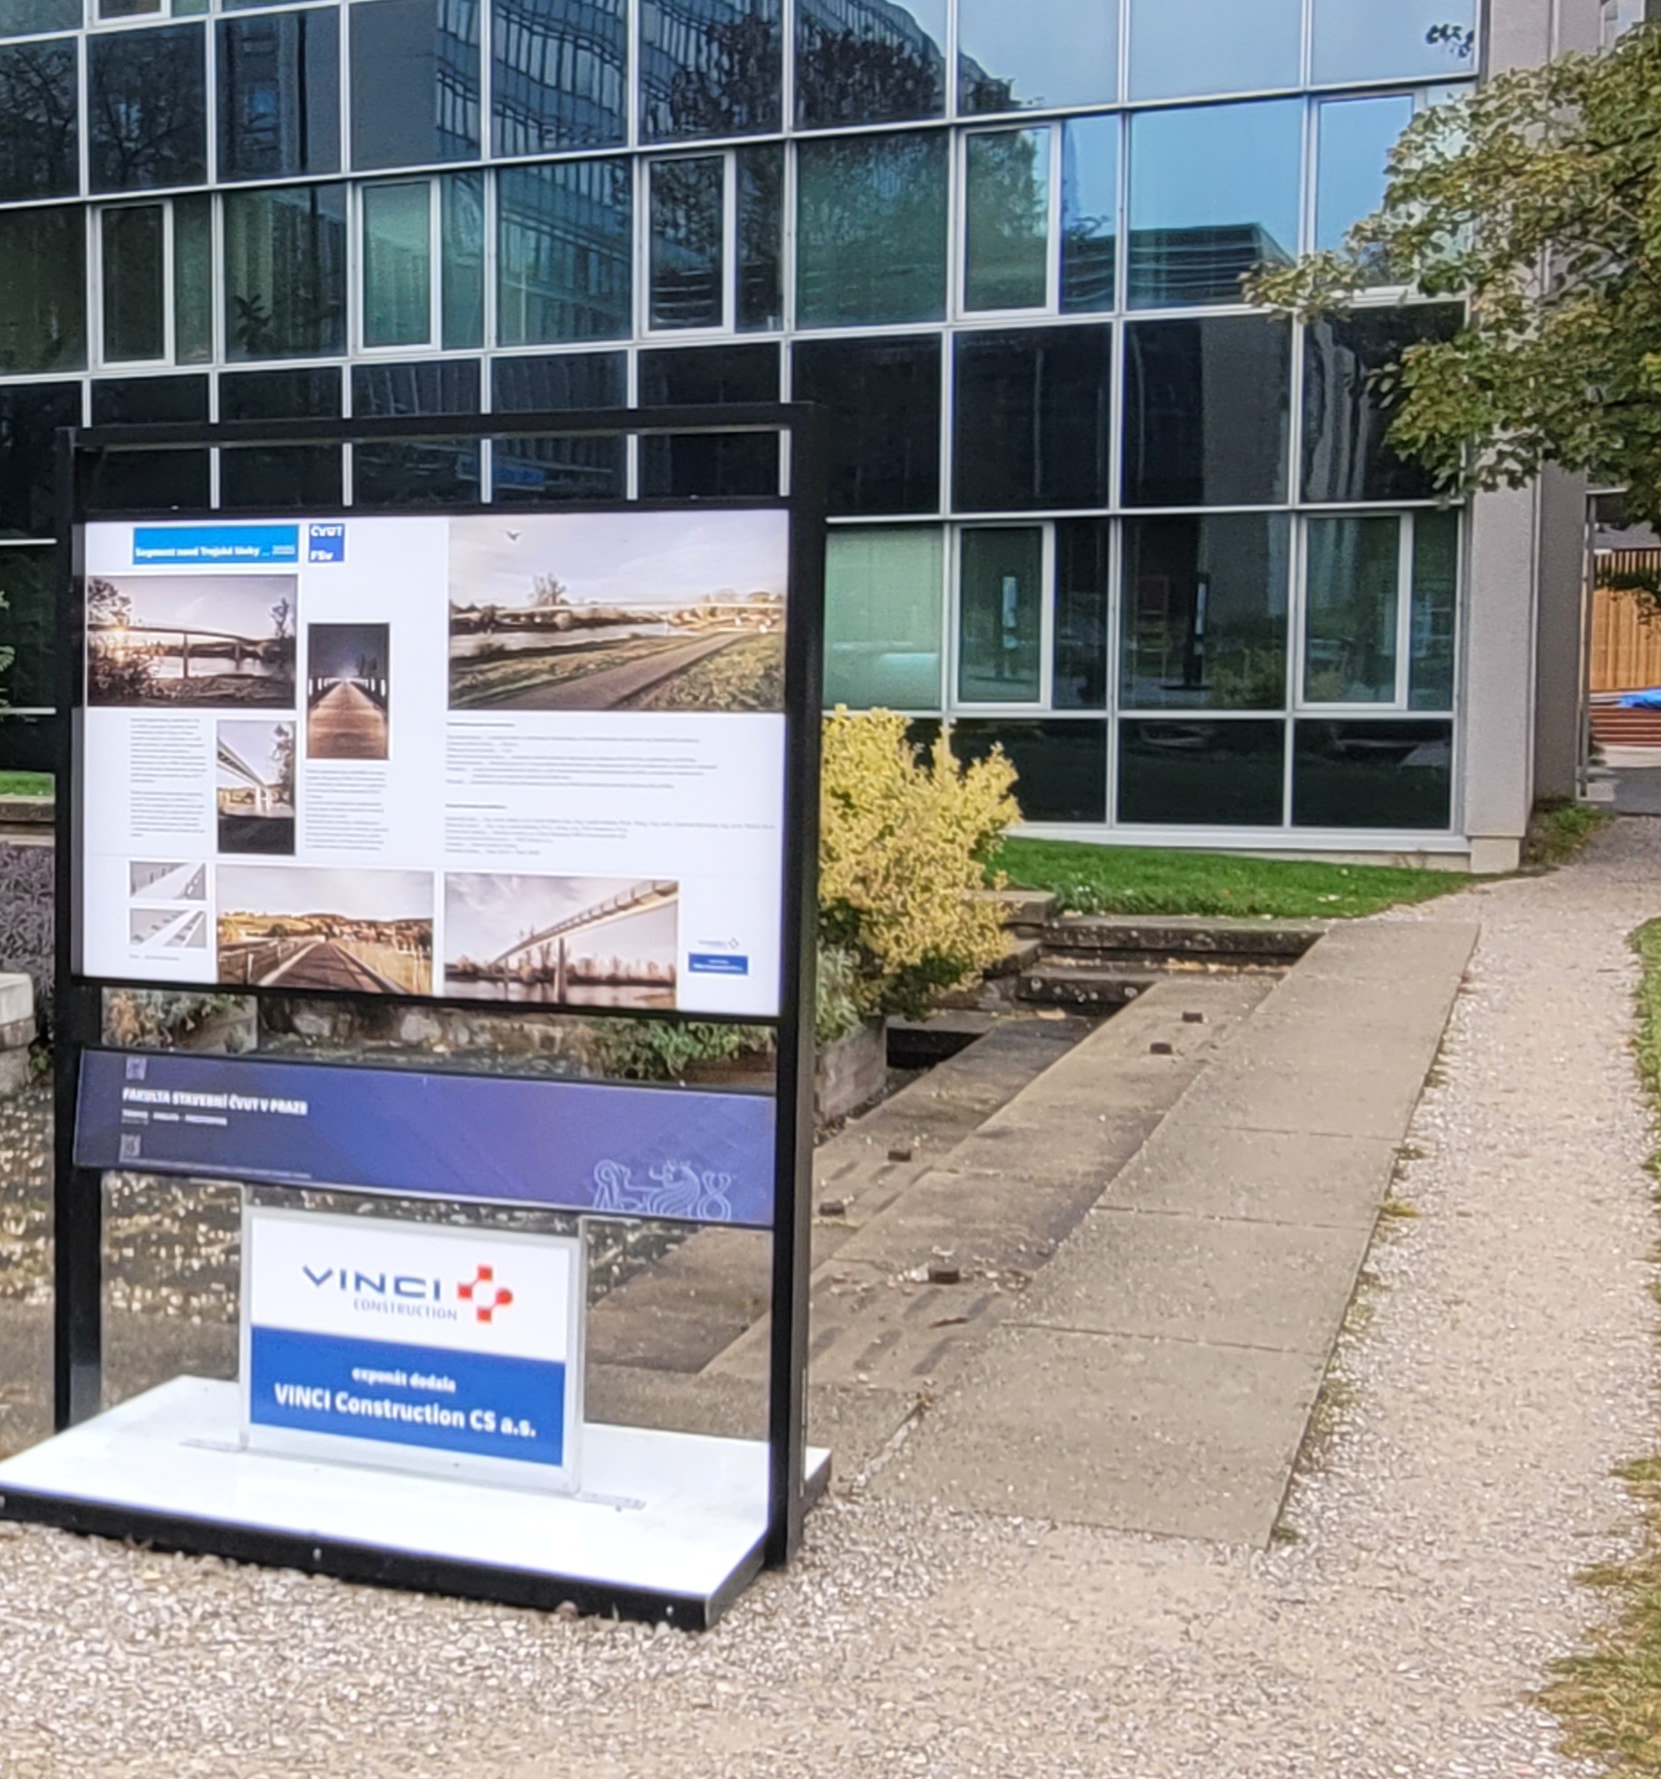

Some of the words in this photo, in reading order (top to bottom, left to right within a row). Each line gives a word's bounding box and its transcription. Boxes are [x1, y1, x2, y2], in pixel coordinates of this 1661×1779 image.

[122, 1087, 171, 1104] FAKULTA
[229, 1092, 259, 1113] ČVUT
[260, 1098, 270, 1113] V
[270, 1099, 308, 1116] PRAZE
[302, 1265, 441, 1302] VINCI
[353, 1297, 458, 1321] CONSTRUCTION
[351, 1367, 408, 1388] exponát
[409, 1370, 456, 1393] dodala
[274, 1382, 331, 1412] VINCI
[335, 1390, 466, 1429] Construction
[469, 1408, 496, 1432] CS
[500, 1416, 537, 1438] a.s.
